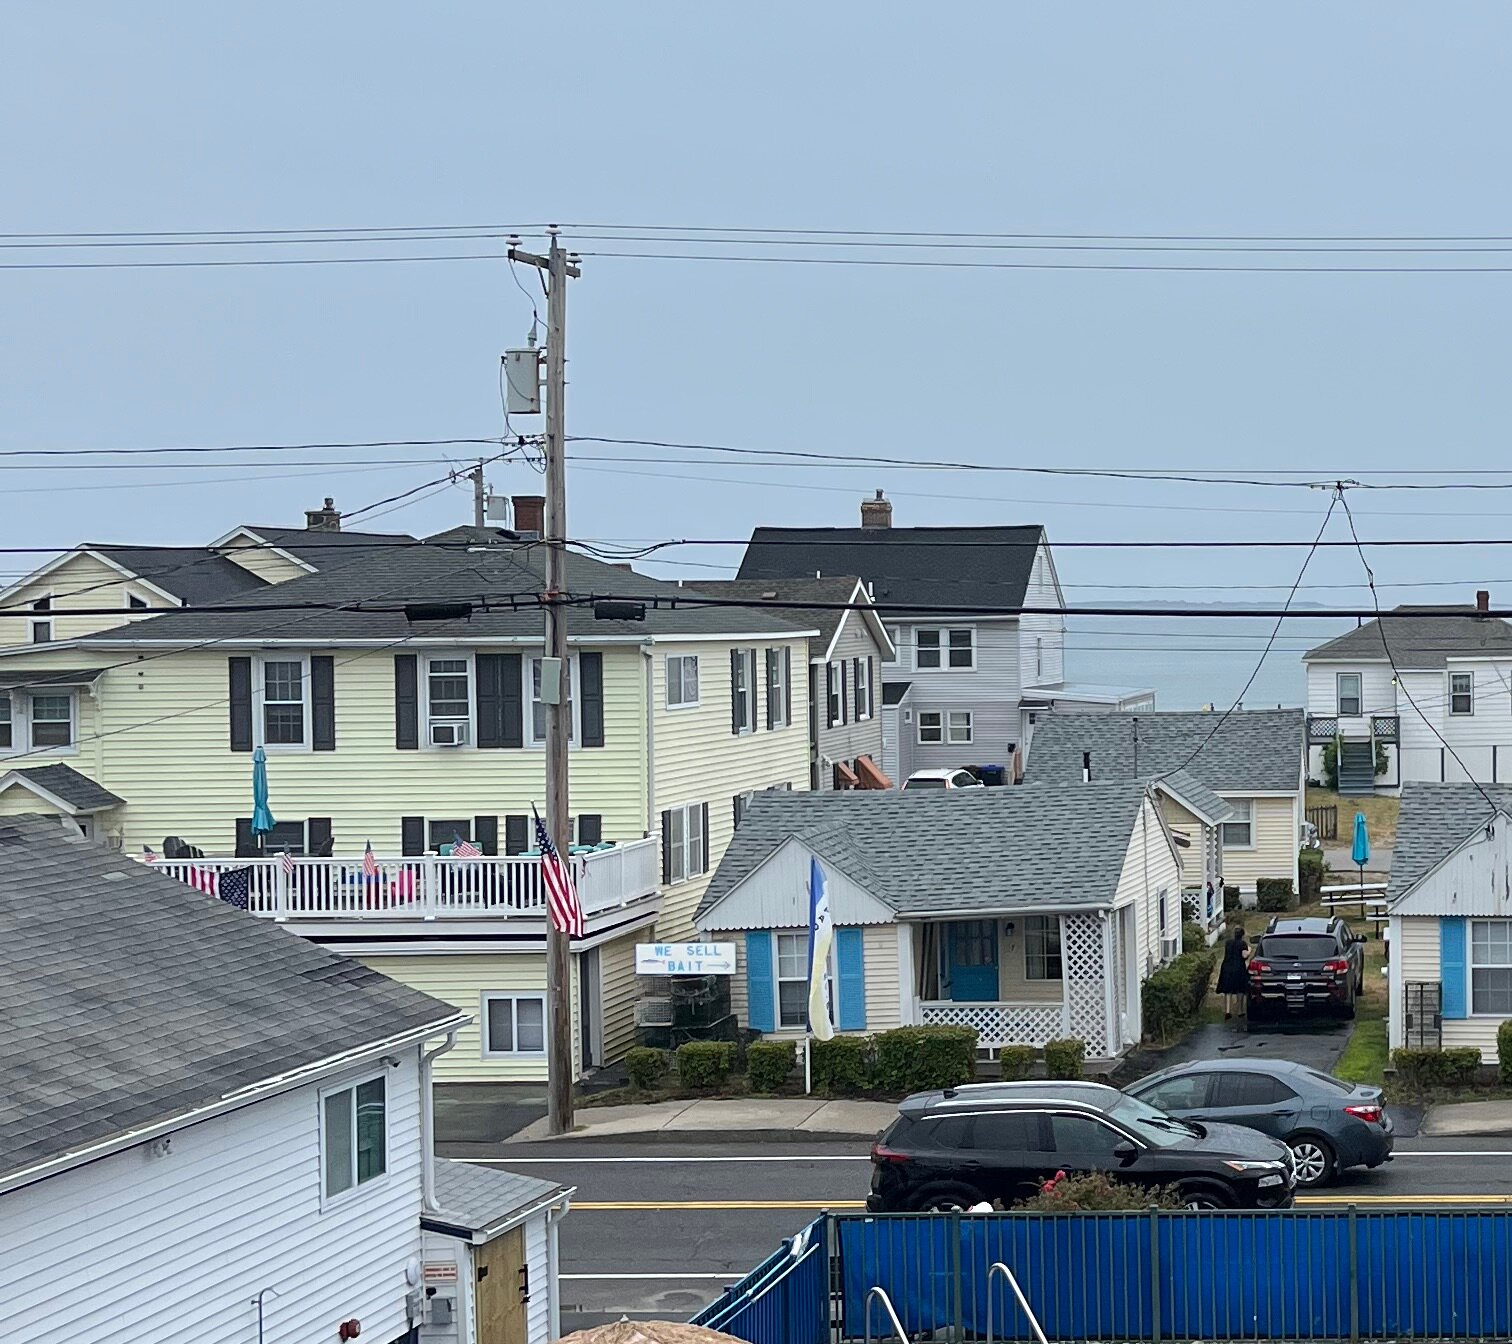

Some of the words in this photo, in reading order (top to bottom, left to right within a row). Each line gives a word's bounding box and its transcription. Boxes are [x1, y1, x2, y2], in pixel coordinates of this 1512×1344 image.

[655, 946, 672, 956] WE
[687, 946, 722, 956] SELL
[668, 961, 703, 971] BAIT
